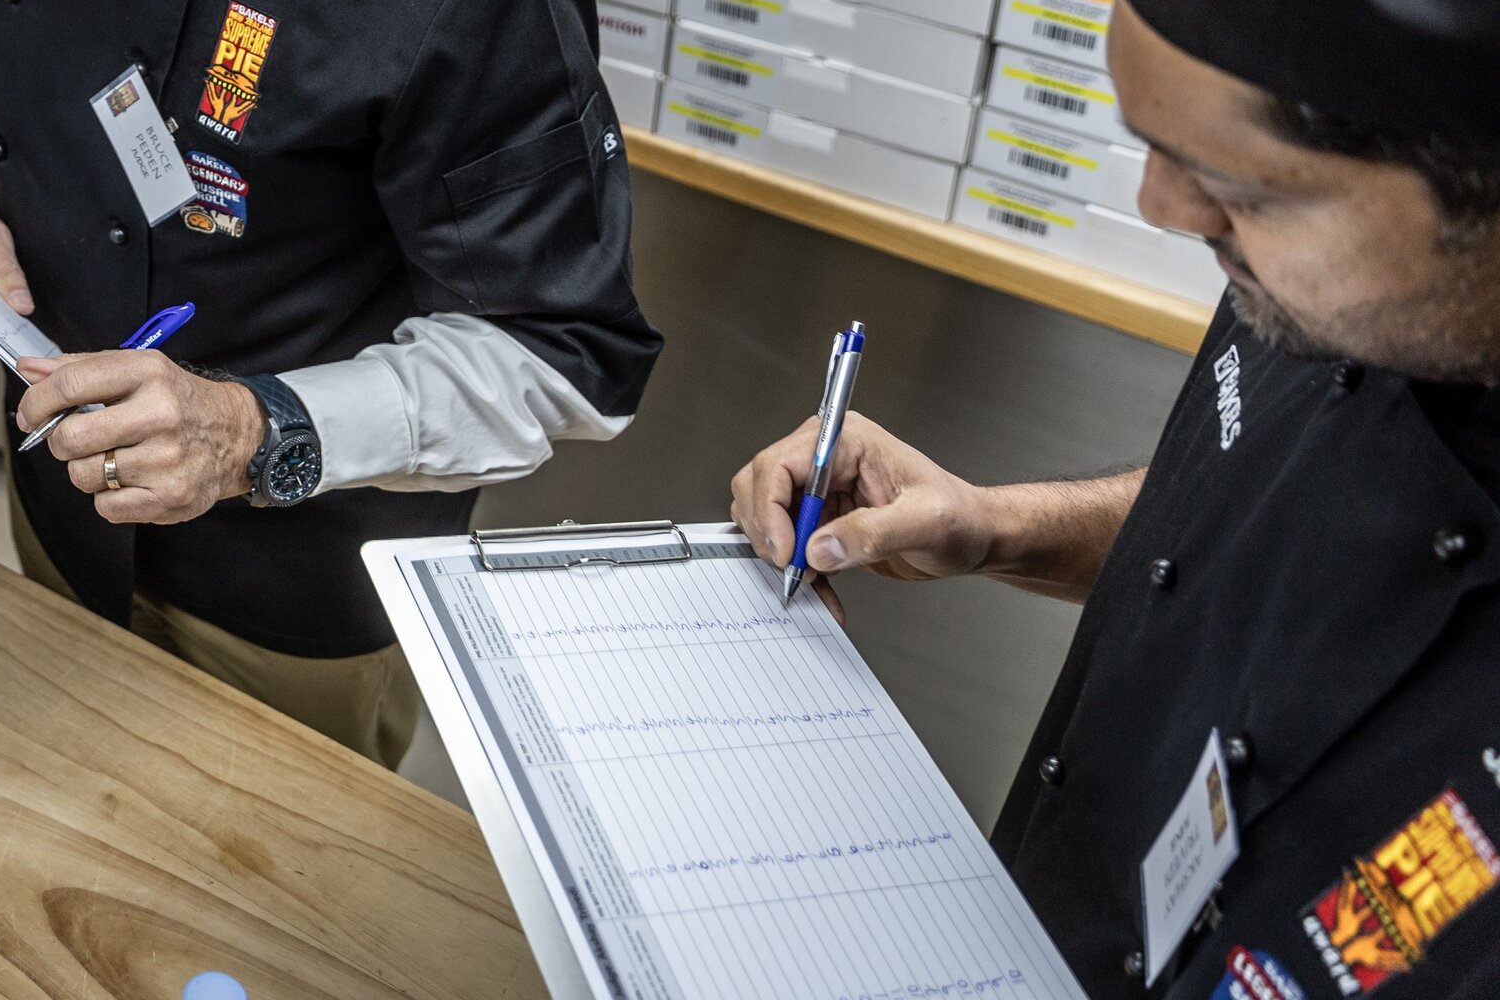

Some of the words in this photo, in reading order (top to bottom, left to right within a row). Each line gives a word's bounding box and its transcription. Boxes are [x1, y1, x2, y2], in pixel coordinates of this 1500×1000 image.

[229, 10, 244, 23] NEW
[245, 17, 274, 36] ZEALAND
[238, 5, 276, 28] BAKELS
[222, 17, 273, 57] SUPREME
[215, 40, 264, 83] PIE
[199, 114, 237, 141] award
[130, 147, 150, 178] JUDGE
[135, 133, 162, 180] PEDEN
[145, 125, 174, 174] BRUCE
[192, 154, 232, 174] BAKELS
[186, 163, 246, 191] EGENDARY
[193, 180, 240, 203] AUSAGE
[1217, 367, 1241, 451] BAKELS
[1374, 830, 1441, 940] PIE
